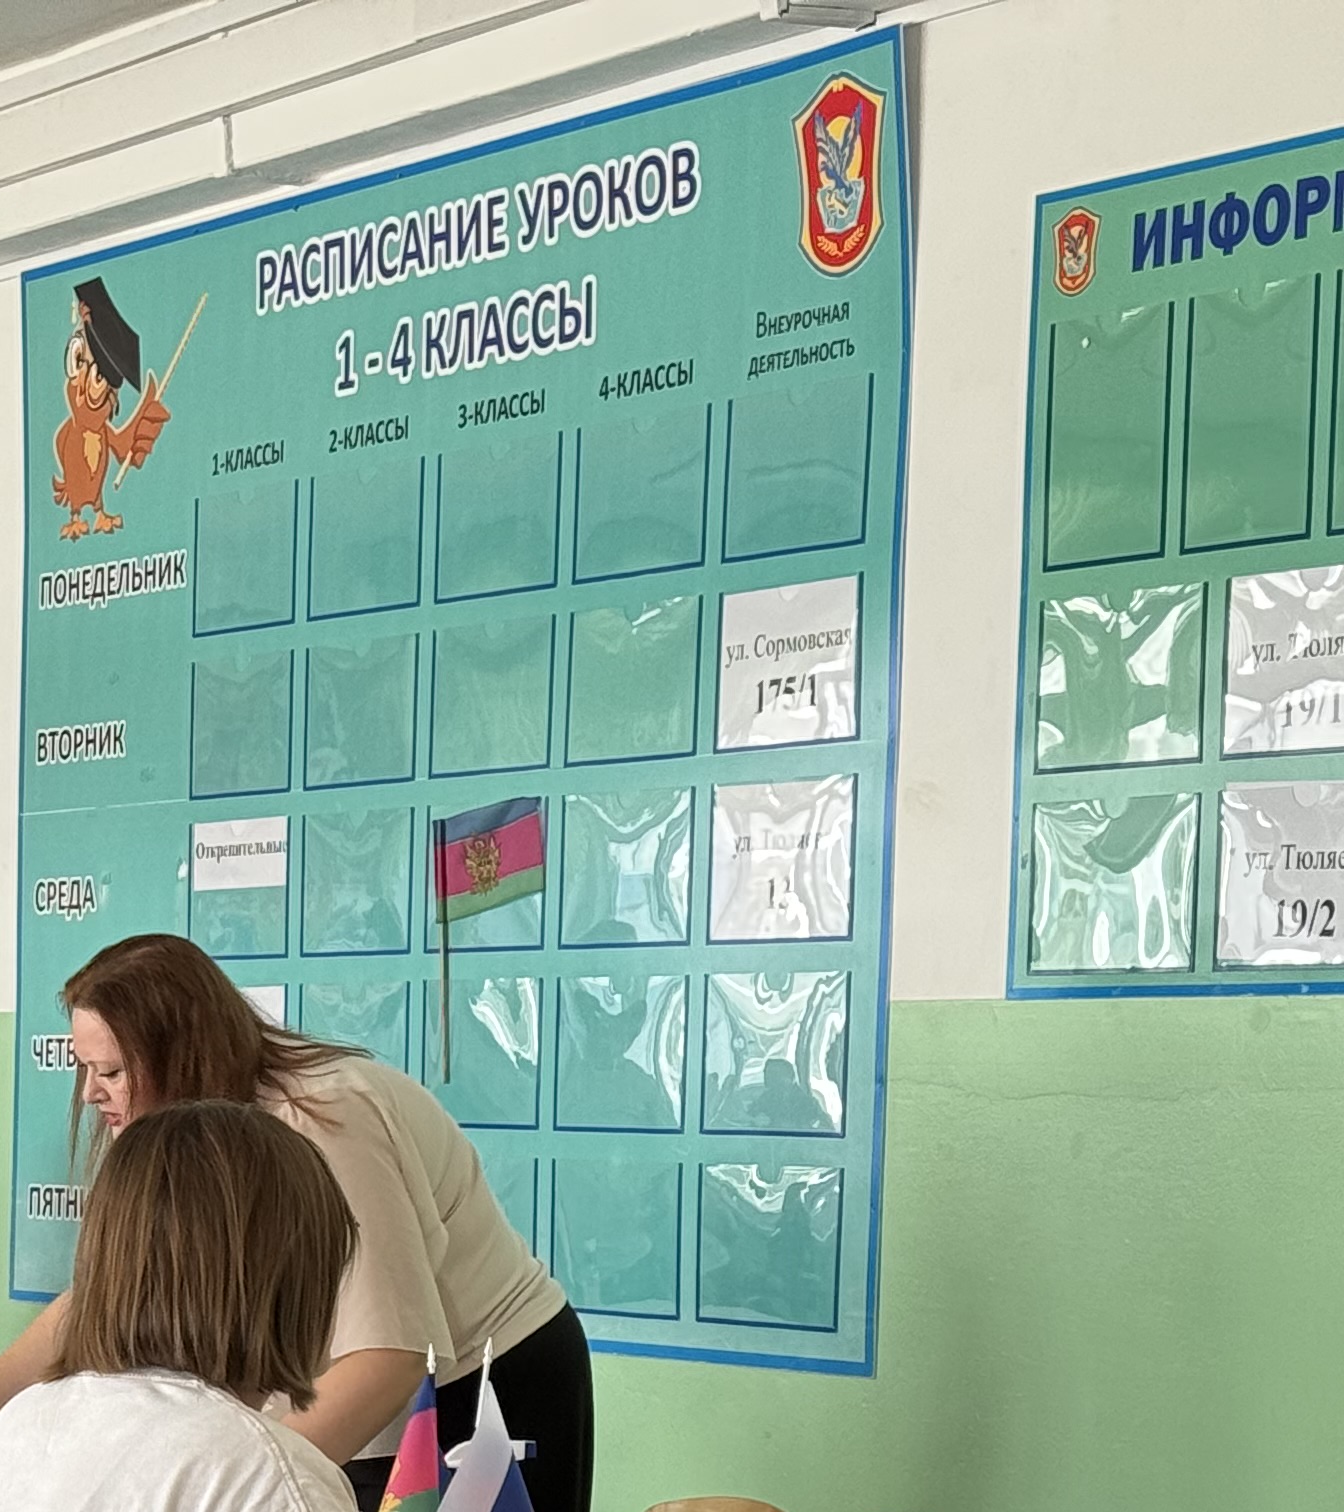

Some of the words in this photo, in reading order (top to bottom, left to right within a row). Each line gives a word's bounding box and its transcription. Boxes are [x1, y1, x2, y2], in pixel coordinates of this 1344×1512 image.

[257, 193, 507, 311] РАСПИСАНИЕ
[517, 146, 700, 248] УРОКОВ
[1132, 170, 1344, 273] ИНФОР
[336, 335, 356, 392] 1
[390, 323, 412, 379] 4
[425, 280, 595, 374] КЛАССЫ
[599, 359, 694, 401] 4-КЛАССЫ
[457, 388, 546, 428] 3-КЛАССЫ
[328, 415, 409, 453] 2-КЛАССЫ
[211, 440, 285, 476] 1-КЛАССЫ
[40, 550, 187, 609] ПОНЕДЕЛЬНИК
[725, 643, 750, 668] ул.
[755, 673, 816, 714] 175/1
[37, 722, 125, 764] ВТОРНИК
[1244, 850, 1273, 878] ул.
[35, 878, 96, 919] СРЕДА
[1273, 898, 1336, 938] 19/2
[31, 1036, 77, 1070] ЧЕТВ
[28, 1185, 85, 1220] ПЯТН
